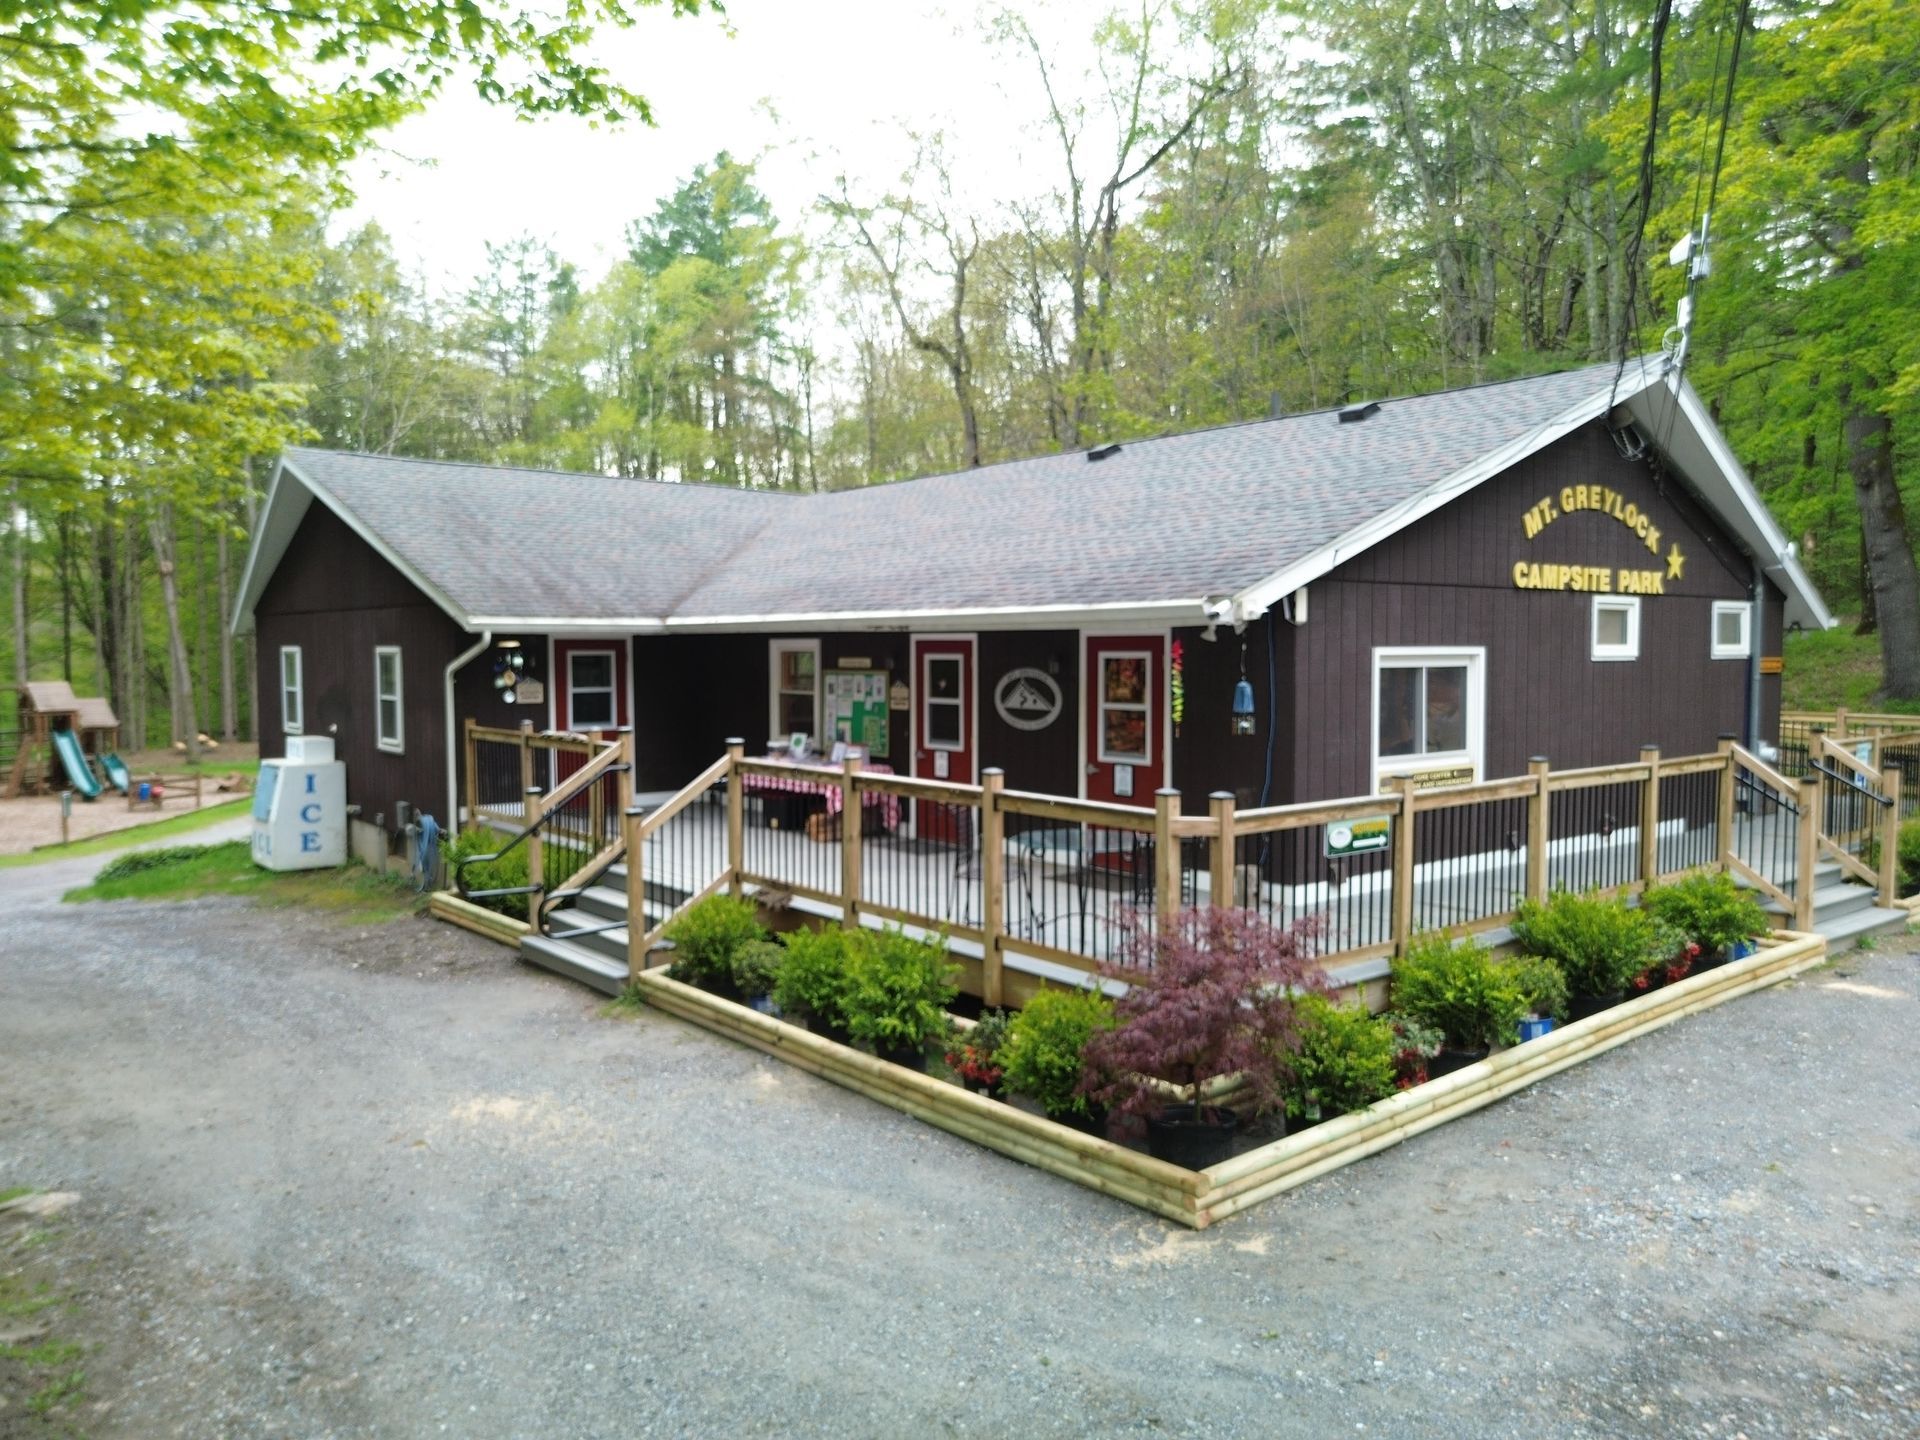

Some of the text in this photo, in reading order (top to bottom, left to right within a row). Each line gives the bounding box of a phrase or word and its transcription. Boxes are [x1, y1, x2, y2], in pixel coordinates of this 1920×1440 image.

[1522, 484, 1662, 554] MT. GREYLOCK
[1513, 561, 1664, 594] CAMPSITE PARK
[301, 773, 321, 852] ICE
